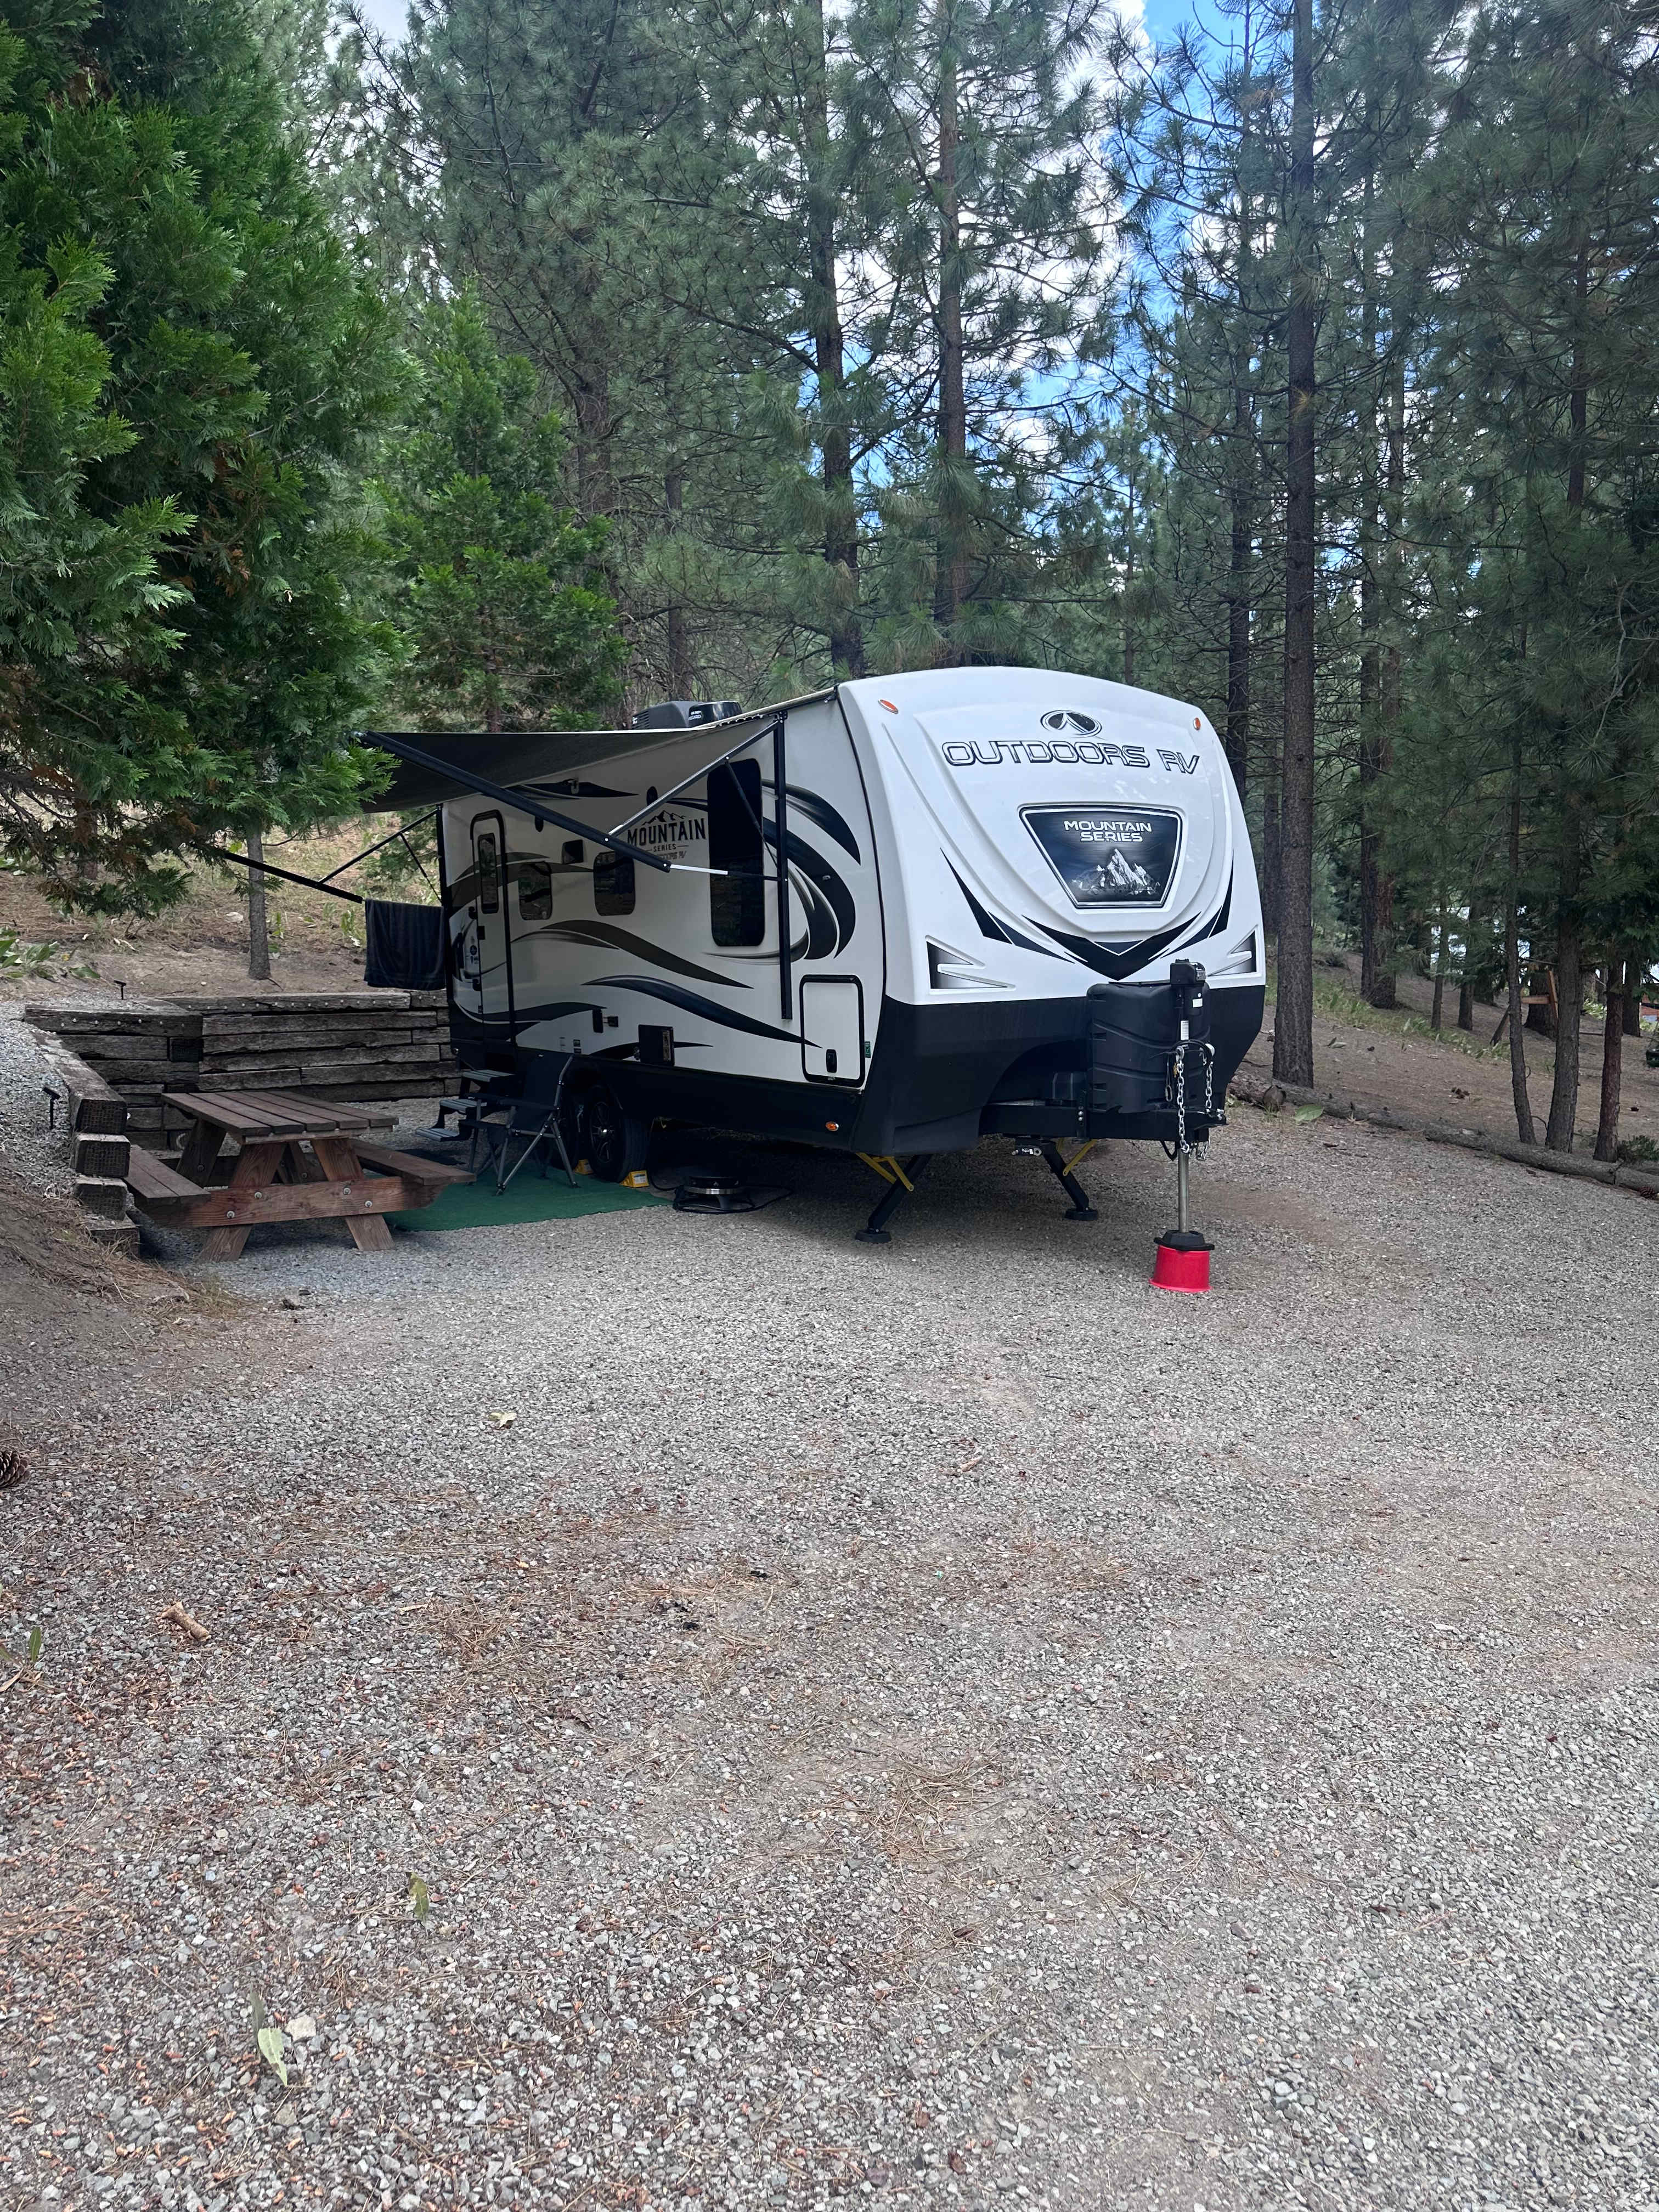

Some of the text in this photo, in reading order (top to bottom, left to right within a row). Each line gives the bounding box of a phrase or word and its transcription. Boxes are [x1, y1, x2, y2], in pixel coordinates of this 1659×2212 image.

[941, 740, 1200, 774] OUTDOORS RV
[628, 818, 706, 846] MOUNTAIN
[1064, 821, 1152, 832] MOUNTAIN
[1080, 832, 1143, 842] SERIES
[653, 843, 676, 852] SERIES
